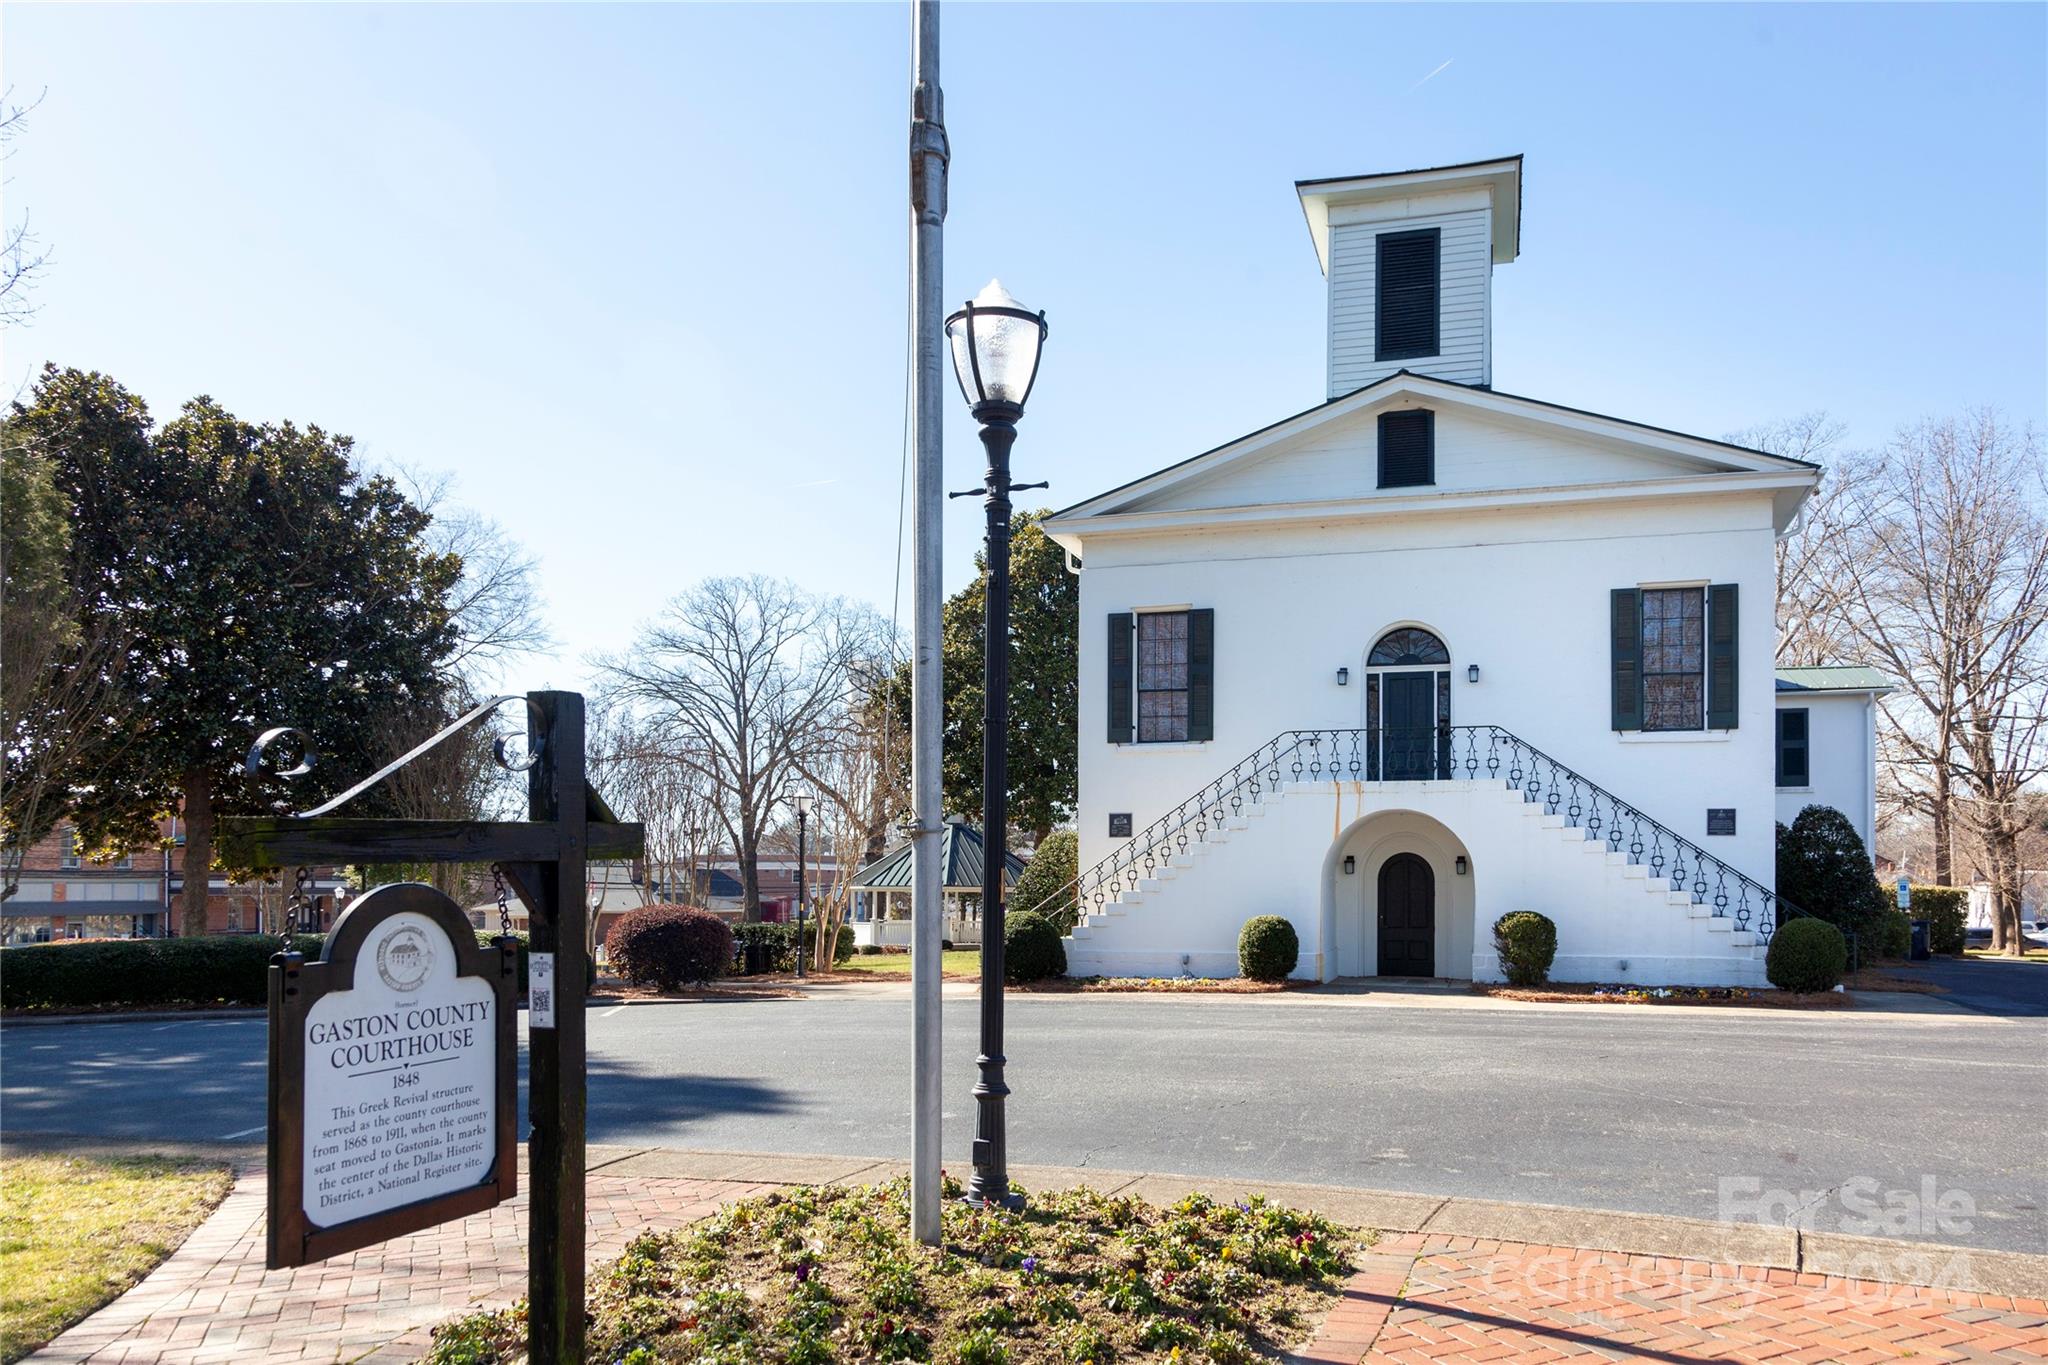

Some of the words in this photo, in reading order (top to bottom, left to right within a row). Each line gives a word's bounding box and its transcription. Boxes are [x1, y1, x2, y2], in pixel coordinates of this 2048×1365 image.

[309, 1013, 399, 1045] GASTON
[406, 1001, 490, 1031] COUNTY
[331, 1028, 474, 1069] COURTHOUSE
[331, 1107, 355, 1120] This
[359, 1098, 389, 1115] Greek
[393, 1090, 428, 1107] Revival
[432, 1084, 474, 1099] structure
[393, 1072, 420, 1089] 1848
[312, 1144, 339, 1158] from
[344, 1134, 368, 1151] 1868
[371, 1135, 382, 1144] to
[386, 1127, 407, 1141] 1911,
[411, 1122, 436, 1135] when
[440, 1117, 454, 1129] the
[457, 1110, 488, 1125] county
[322, 1120, 356, 1139] served
[360, 1123, 370, 1131] as
[374, 1115, 390, 1128] the
[394, 1108, 427, 1123] county
[430, 1097, 480, 1115] courthouse
[314, 1161, 336, 1175] seat
[341, 1149, 376, 1169] moved
[381, 1149, 391, 1159] to
[395, 1137, 442, 1155] Gastonia.
[446, 1131, 454, 1143] It
[458, 1124, 487, 1140] marks
[318, 1178, 336, 1192] the
[340, 1169, 375, 1186] center
[378, 1161, 389, 1176] of
[393, 1159, 409, 1172] the
[413, 1151, 443, 1167] Dallas
[446, 1140, 484, 1158] Historic
[320, 1188, 364, 1208] District,
[368, 1186, 374, 1195] a
[378, 1170, 420, 1192] National
[424, 1162, 461, 1180] Register
[464, 1157, 483, 1169] site.
